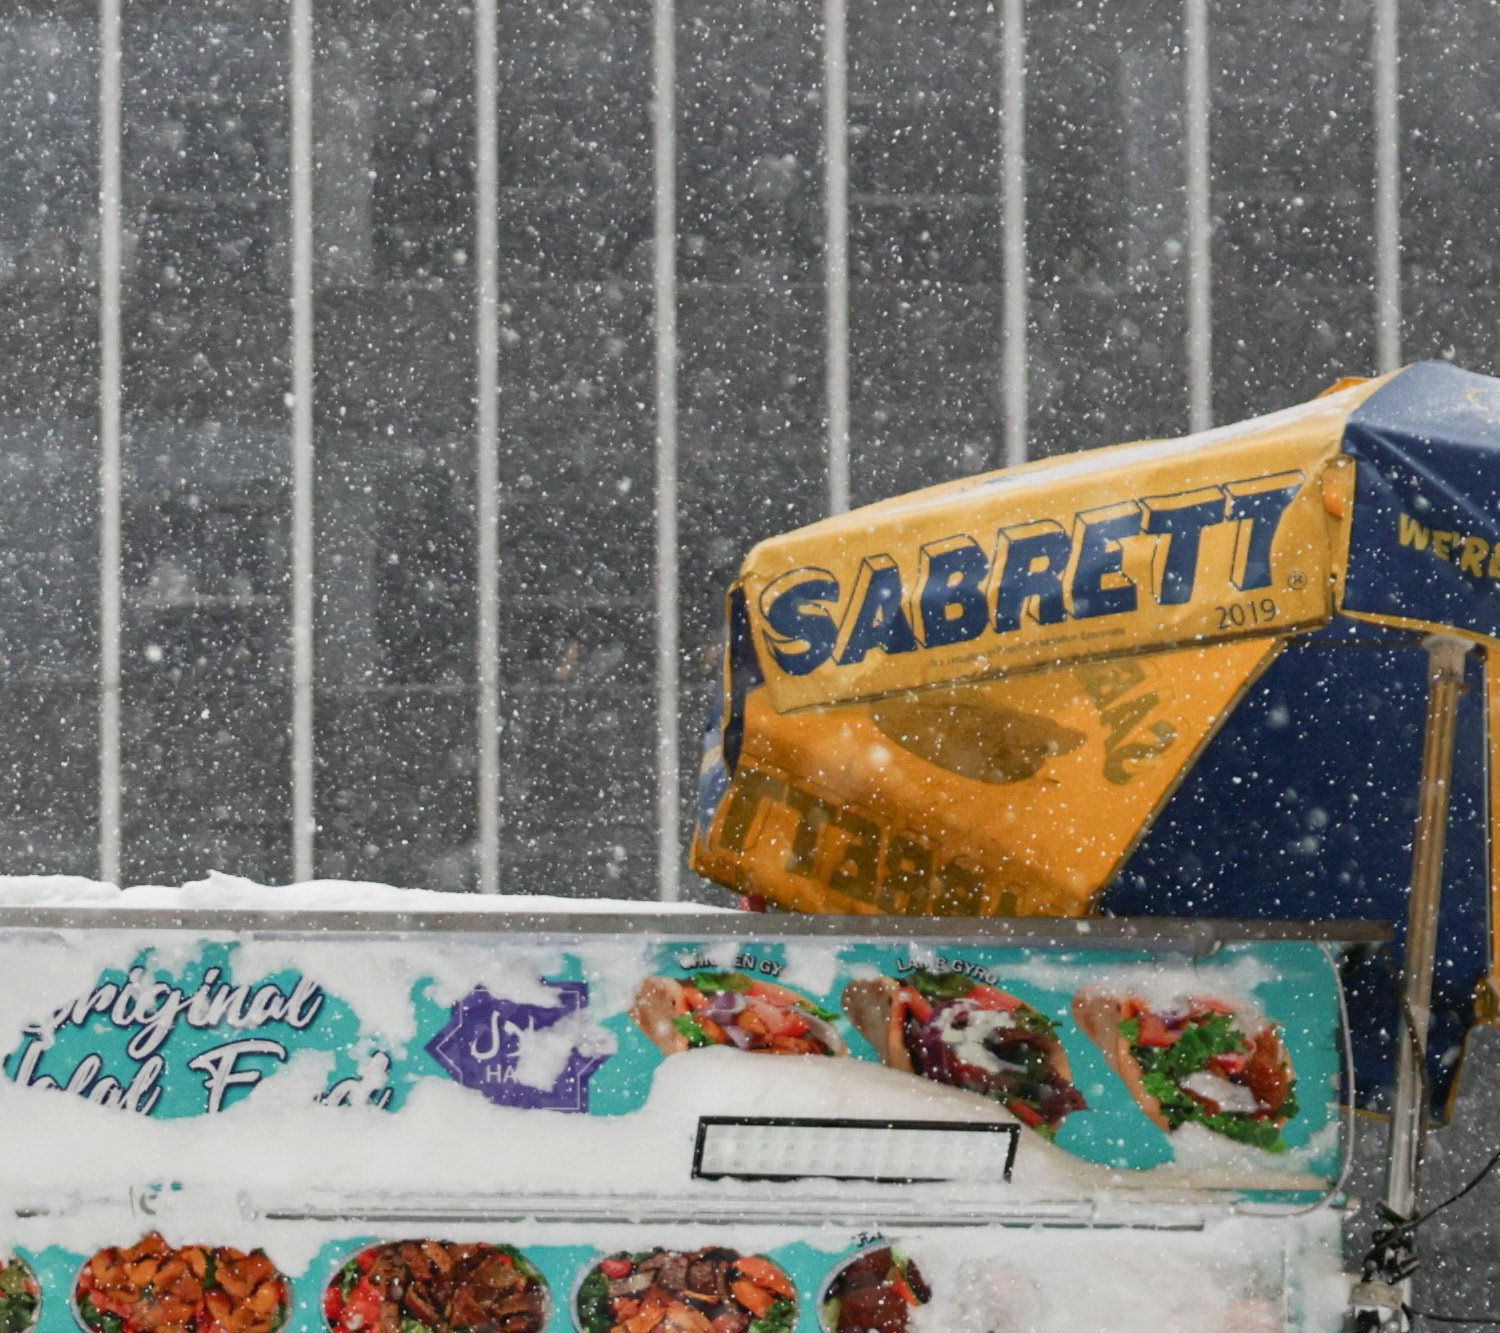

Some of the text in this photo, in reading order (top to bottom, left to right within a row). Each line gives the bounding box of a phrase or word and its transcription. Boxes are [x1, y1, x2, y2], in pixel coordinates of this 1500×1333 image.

[760, 469, 1306, 677] SABRETT
[1215, 598, 1278, 631] 2019
[23, 964, 326, 1060] riginal
